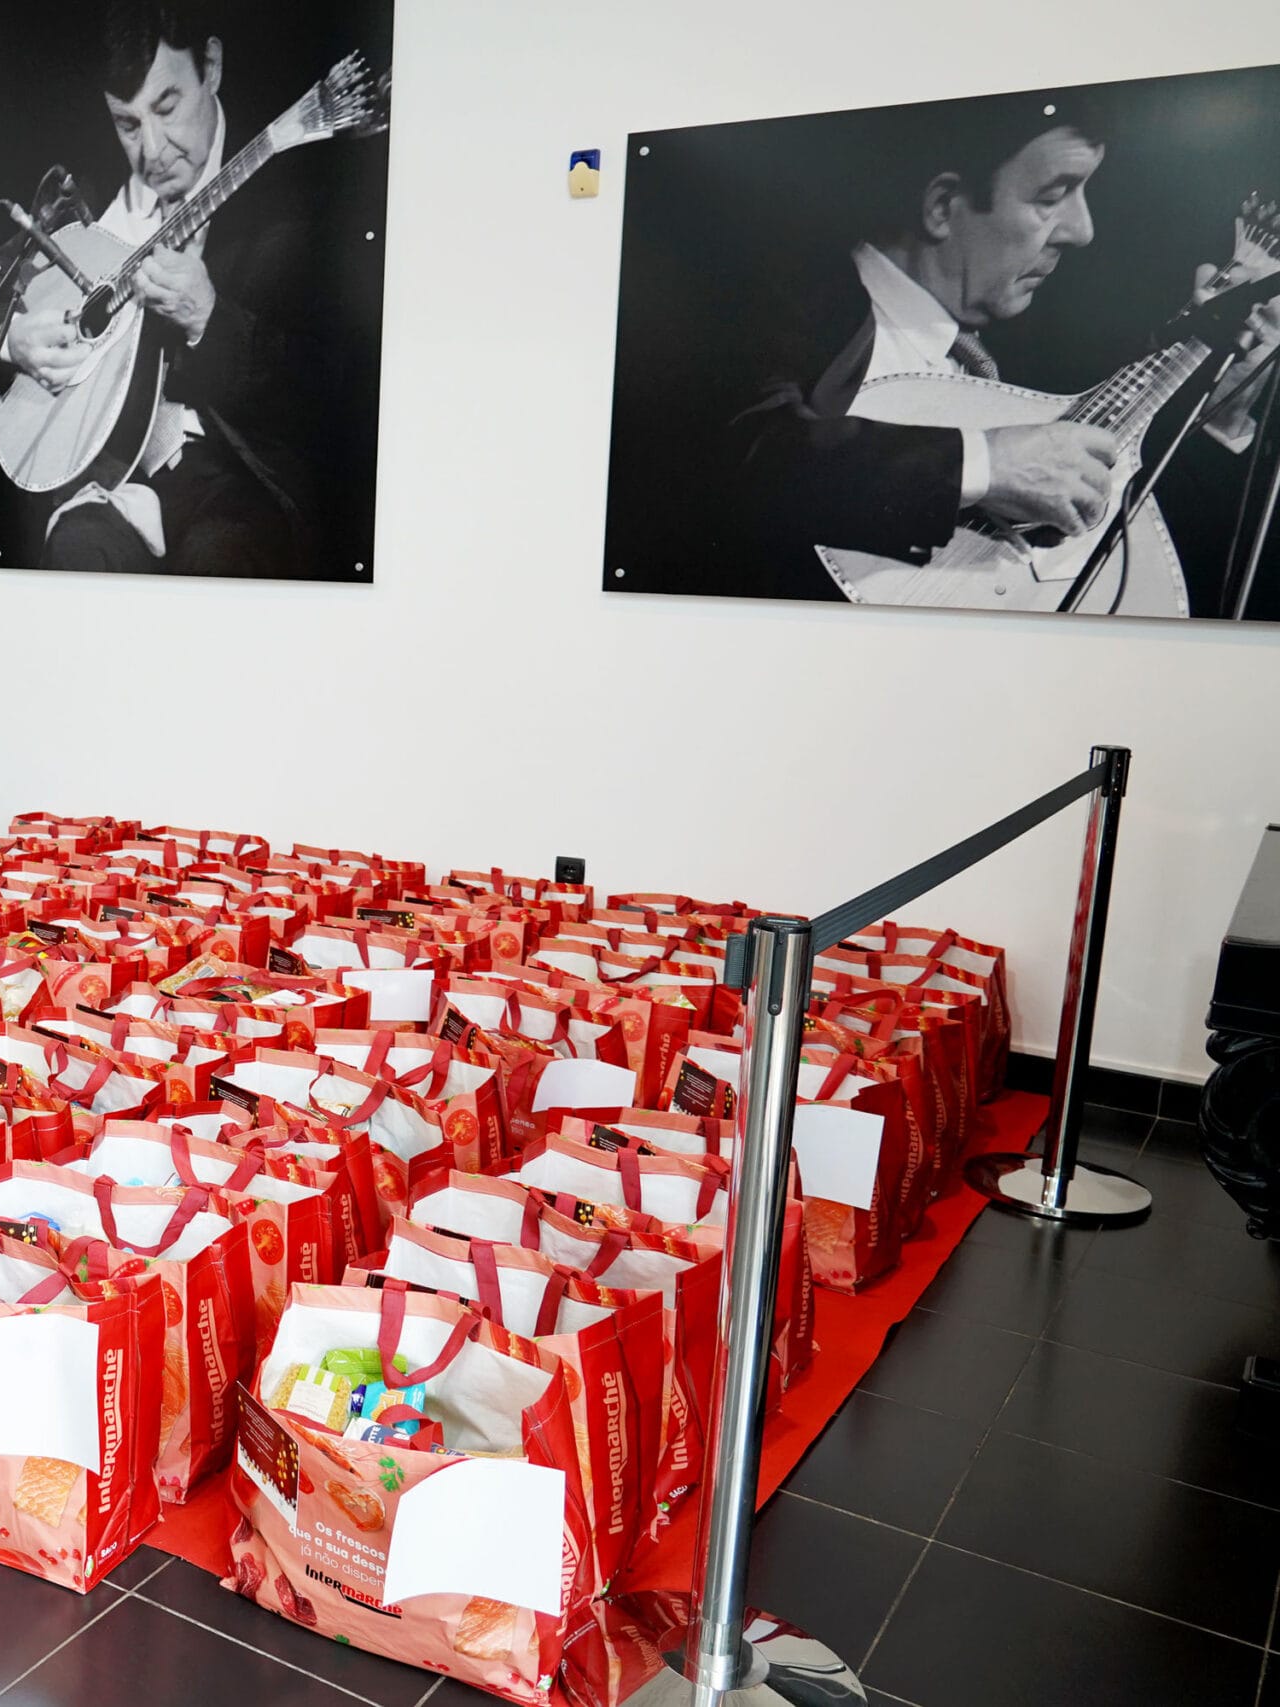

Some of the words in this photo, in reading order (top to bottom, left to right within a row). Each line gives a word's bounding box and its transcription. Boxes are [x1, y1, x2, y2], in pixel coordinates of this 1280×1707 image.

[288, 1525, 311, 1541] que
[314, 1537, 323, 1547] a
[325, 1543, 349, 1559] sua
[352, 1553, 386, 1576] desp
[315, 1521, 333, 1537] Os
[336, 1530, 386, 1561] frescos
[315, 1551, 339, 1569] não
